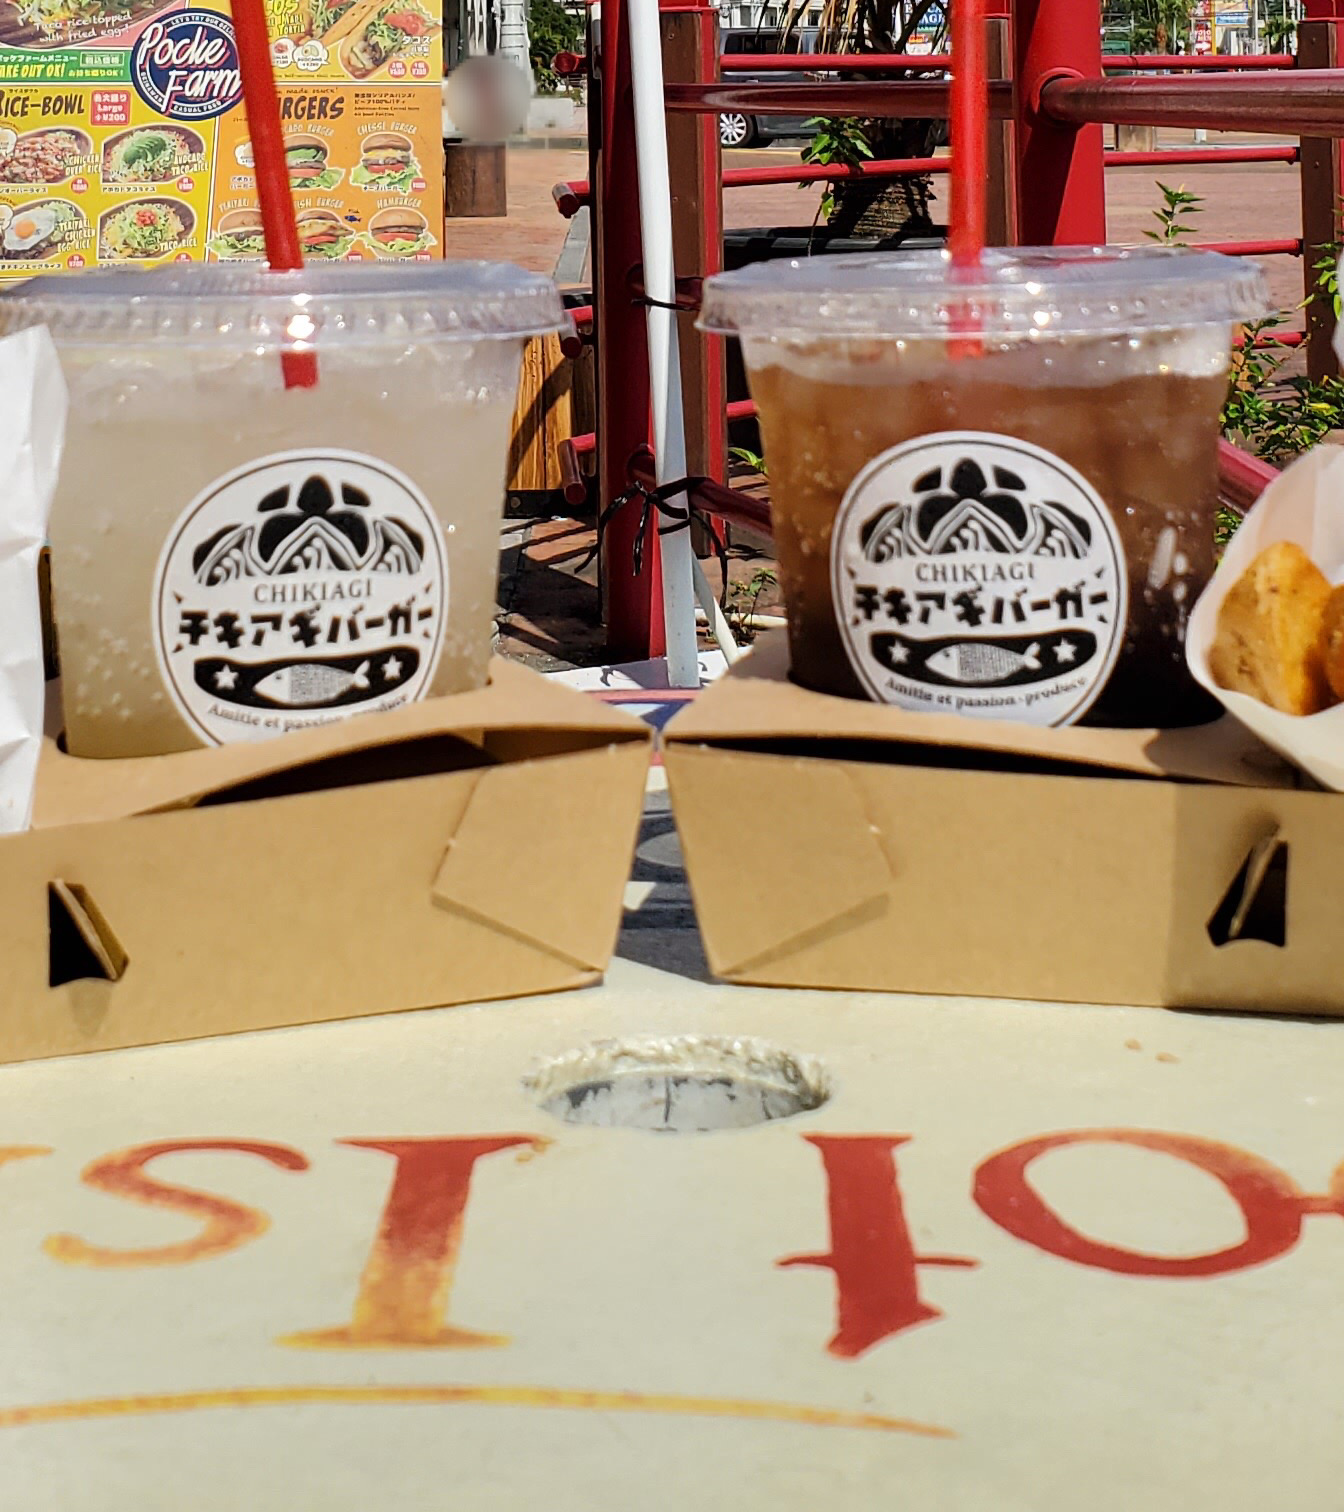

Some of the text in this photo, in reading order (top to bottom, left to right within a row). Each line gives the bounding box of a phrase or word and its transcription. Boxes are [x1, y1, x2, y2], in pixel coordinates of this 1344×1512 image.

[67, 17, 90, 27] rice
[92, 10, 133, 25] topped
[39, 33, 64, 43] with
[68, 28, 97, 42] fried
[21, 64, 44, 78] OUT
[47, 63, 65, 78] OK!
[160, 68, 242, 113] Farm
[97, 103, 123, 112] Large
[916, 562, 1035, 582] CHIKIAGI
[254, 578, 372, 603] CHIKIAGI
[855, 581, 1108, 627] チキアギバーガー
[179, 596, 433, 649] チキアギバーガー
